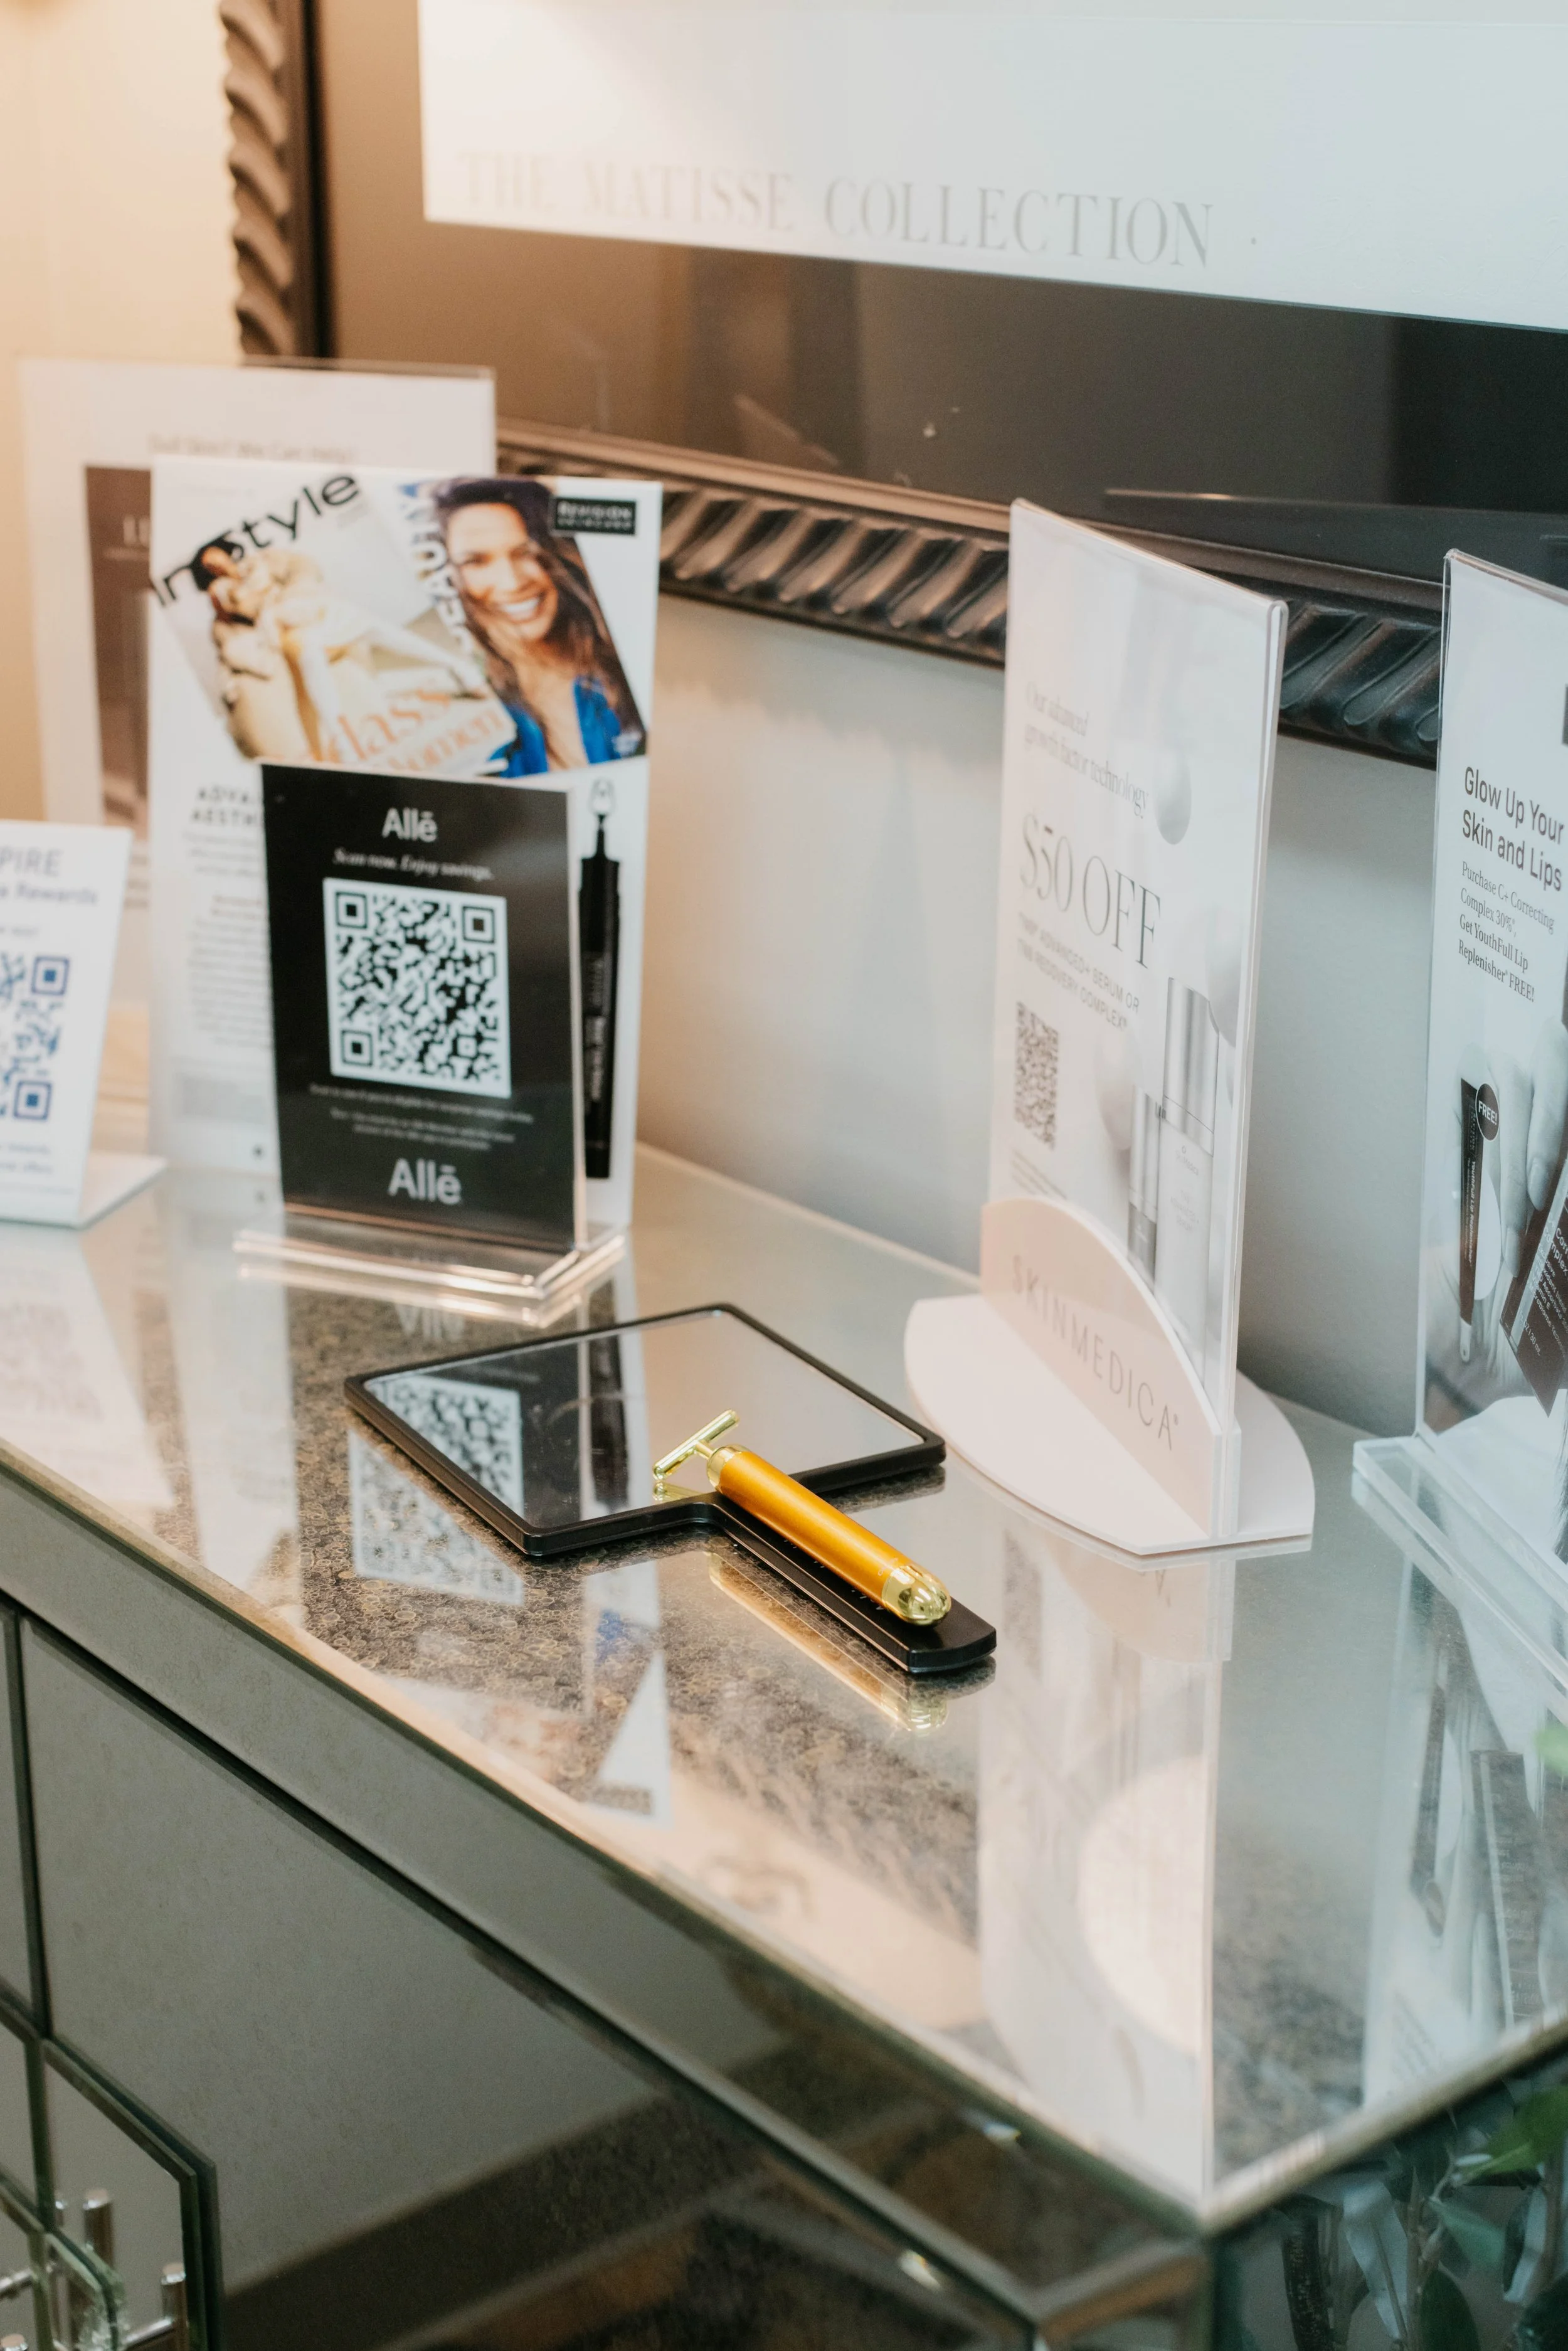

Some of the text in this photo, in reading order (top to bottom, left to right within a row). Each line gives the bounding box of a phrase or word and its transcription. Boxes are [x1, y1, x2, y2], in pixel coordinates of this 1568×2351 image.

[457, 151, 1214, 269] THE MATISSE COLLECTION
[381, 806, 438, 844] Allē
[1465, 766, 1565, 846] Glow Up Your
[1462, 809, 1562, 892] Skin and Lips
[1083, 856, 1161, 969] OFF
[1461, 888, 1494, 923] Complex
[1462, 861, 1555, 935] Purchase C+ Correcting
[1459, 913, 1528, 974] Get YouthFull Lip
[1126, 992, 1140, 1015] OR
[1508, 972, 1534, 1003] FREE!
[1478, 1100, 1497, 1125] FREE!
[387, 1157, 463, 1206] Allē
